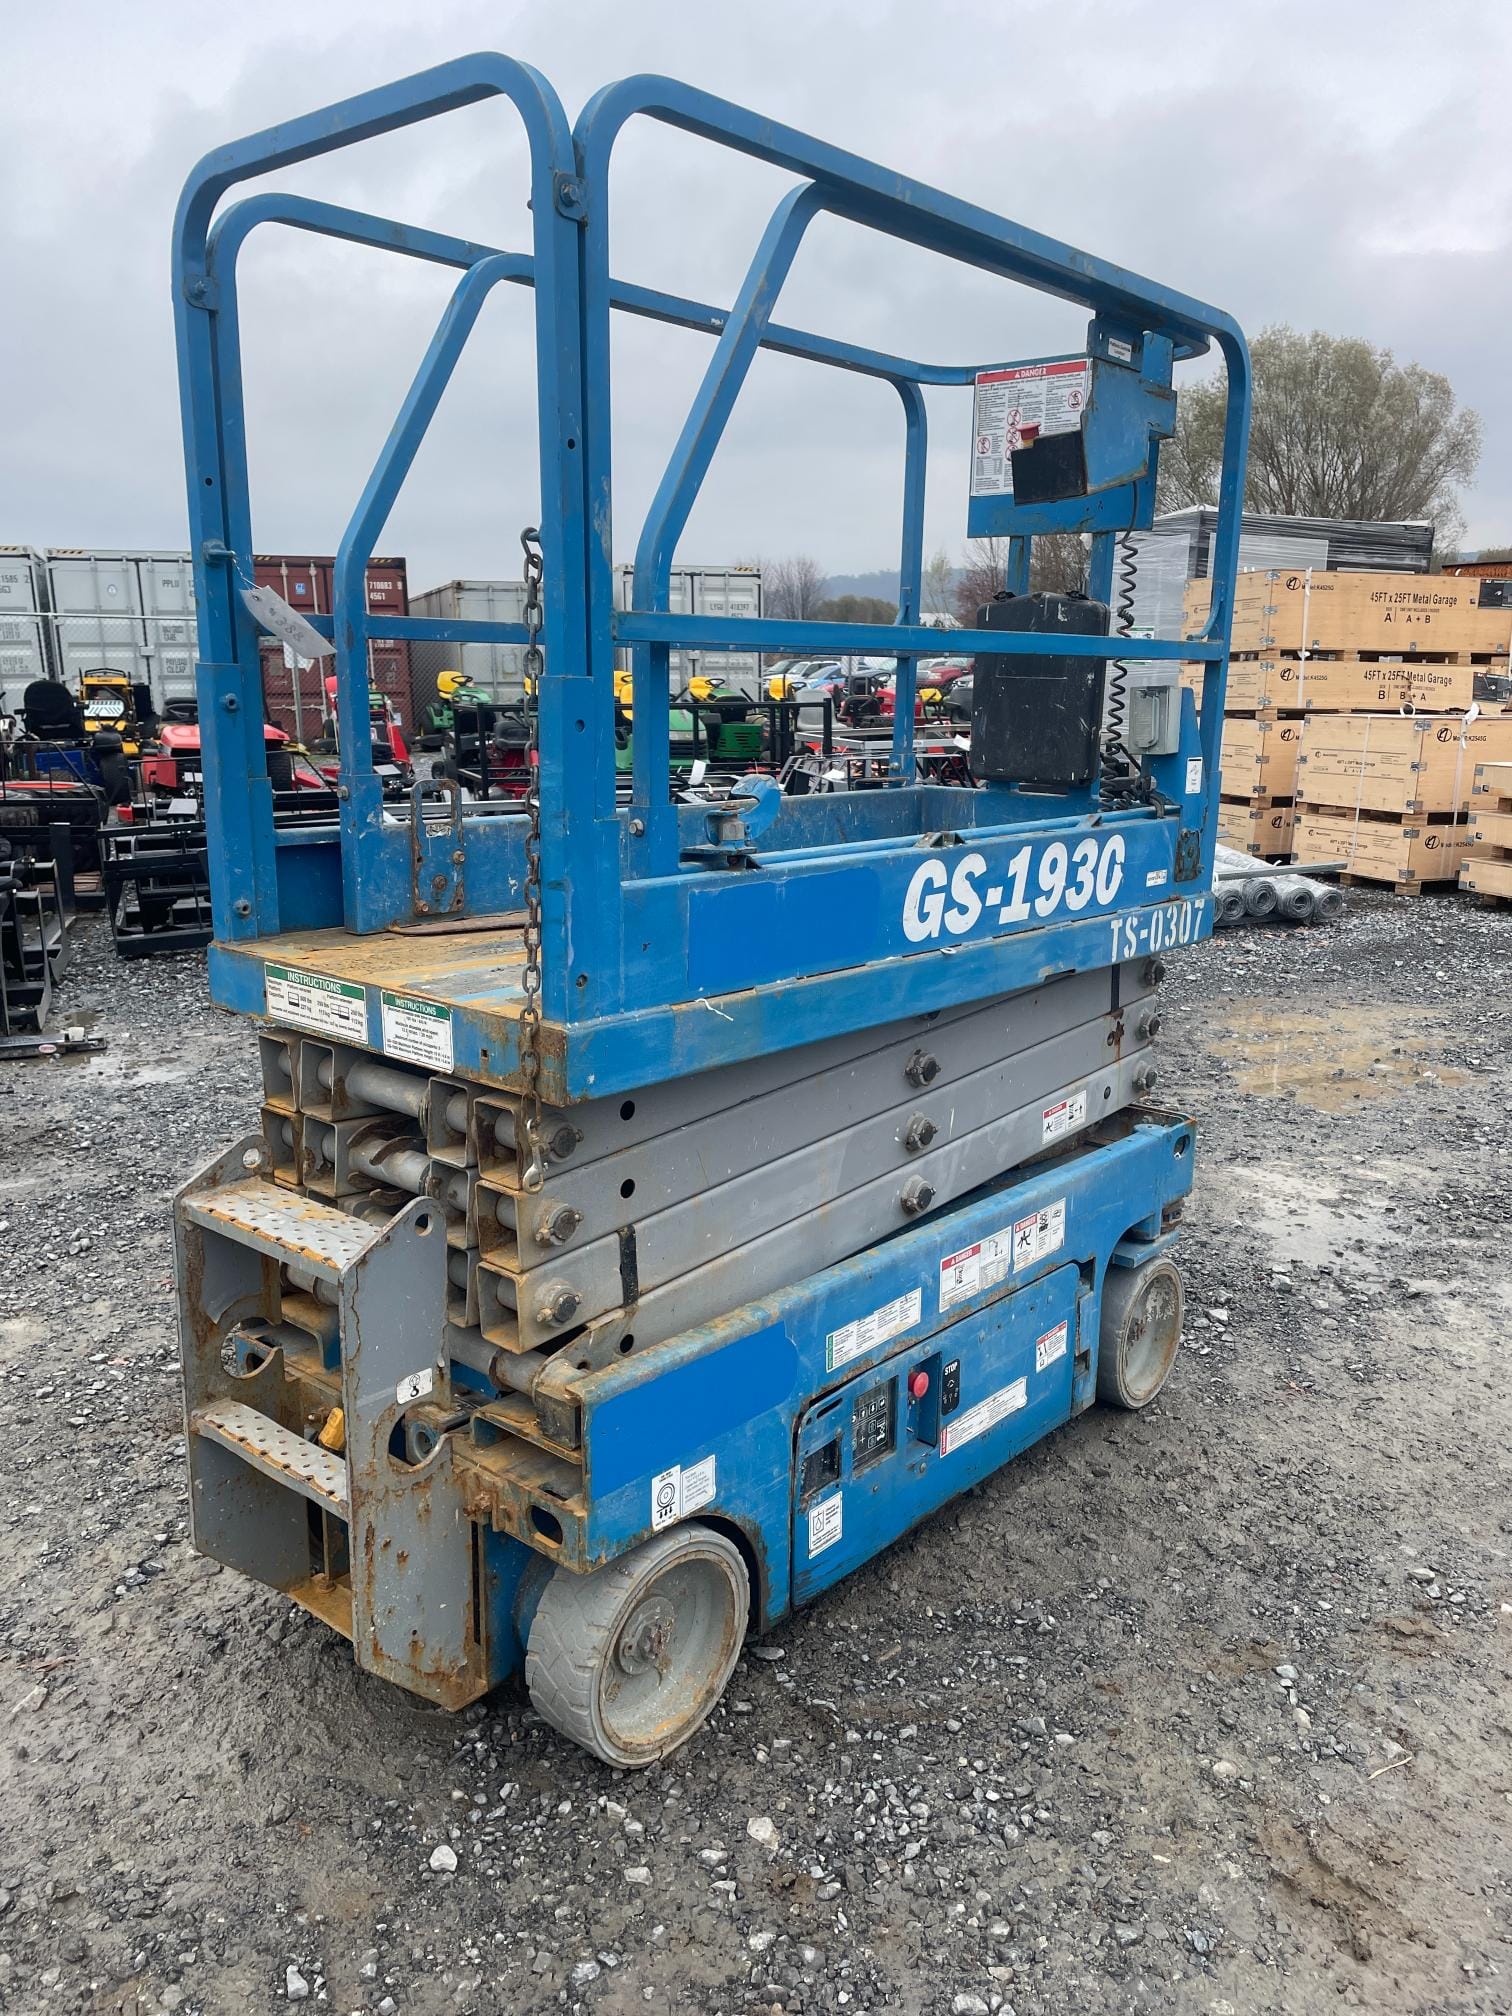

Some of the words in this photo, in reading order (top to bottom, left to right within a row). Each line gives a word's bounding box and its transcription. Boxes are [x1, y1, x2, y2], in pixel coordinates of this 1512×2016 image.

[1370, 591, 1388, 602] 45FT
[1394, 592, 1412, 603] 25FT
[1412, 593, 1431, 604] Metal
[1433, 594, 1458, 607] Garage
[1384, 612, 1392, 623] A
[1406, 614, 1412, 623] A
[1425, 614, 1431, 623] B
[1364, 670, 1381, 681] 45FT
[1388, 671, 1406, 682] 25FT
[1407, 672, 1426, 683] Metal
[1427, 674, 1452, 687] Garage
[1378, 690, 1386, 700] B
[1400, 691, 1406, 700] B
[1420, 692, 1426, 701] A
[902, 833, 1126, 943] GS-1930
[1110, 899, 1205, 963] TS-0307
[287, 971, 341, 994] INSTRUCTIONS
[394, 997, 437, 1016] INSTRUCTIONS
[955, 1248, 973, 1260] DANGER
[944, 1361, 958, 1376] STOP
